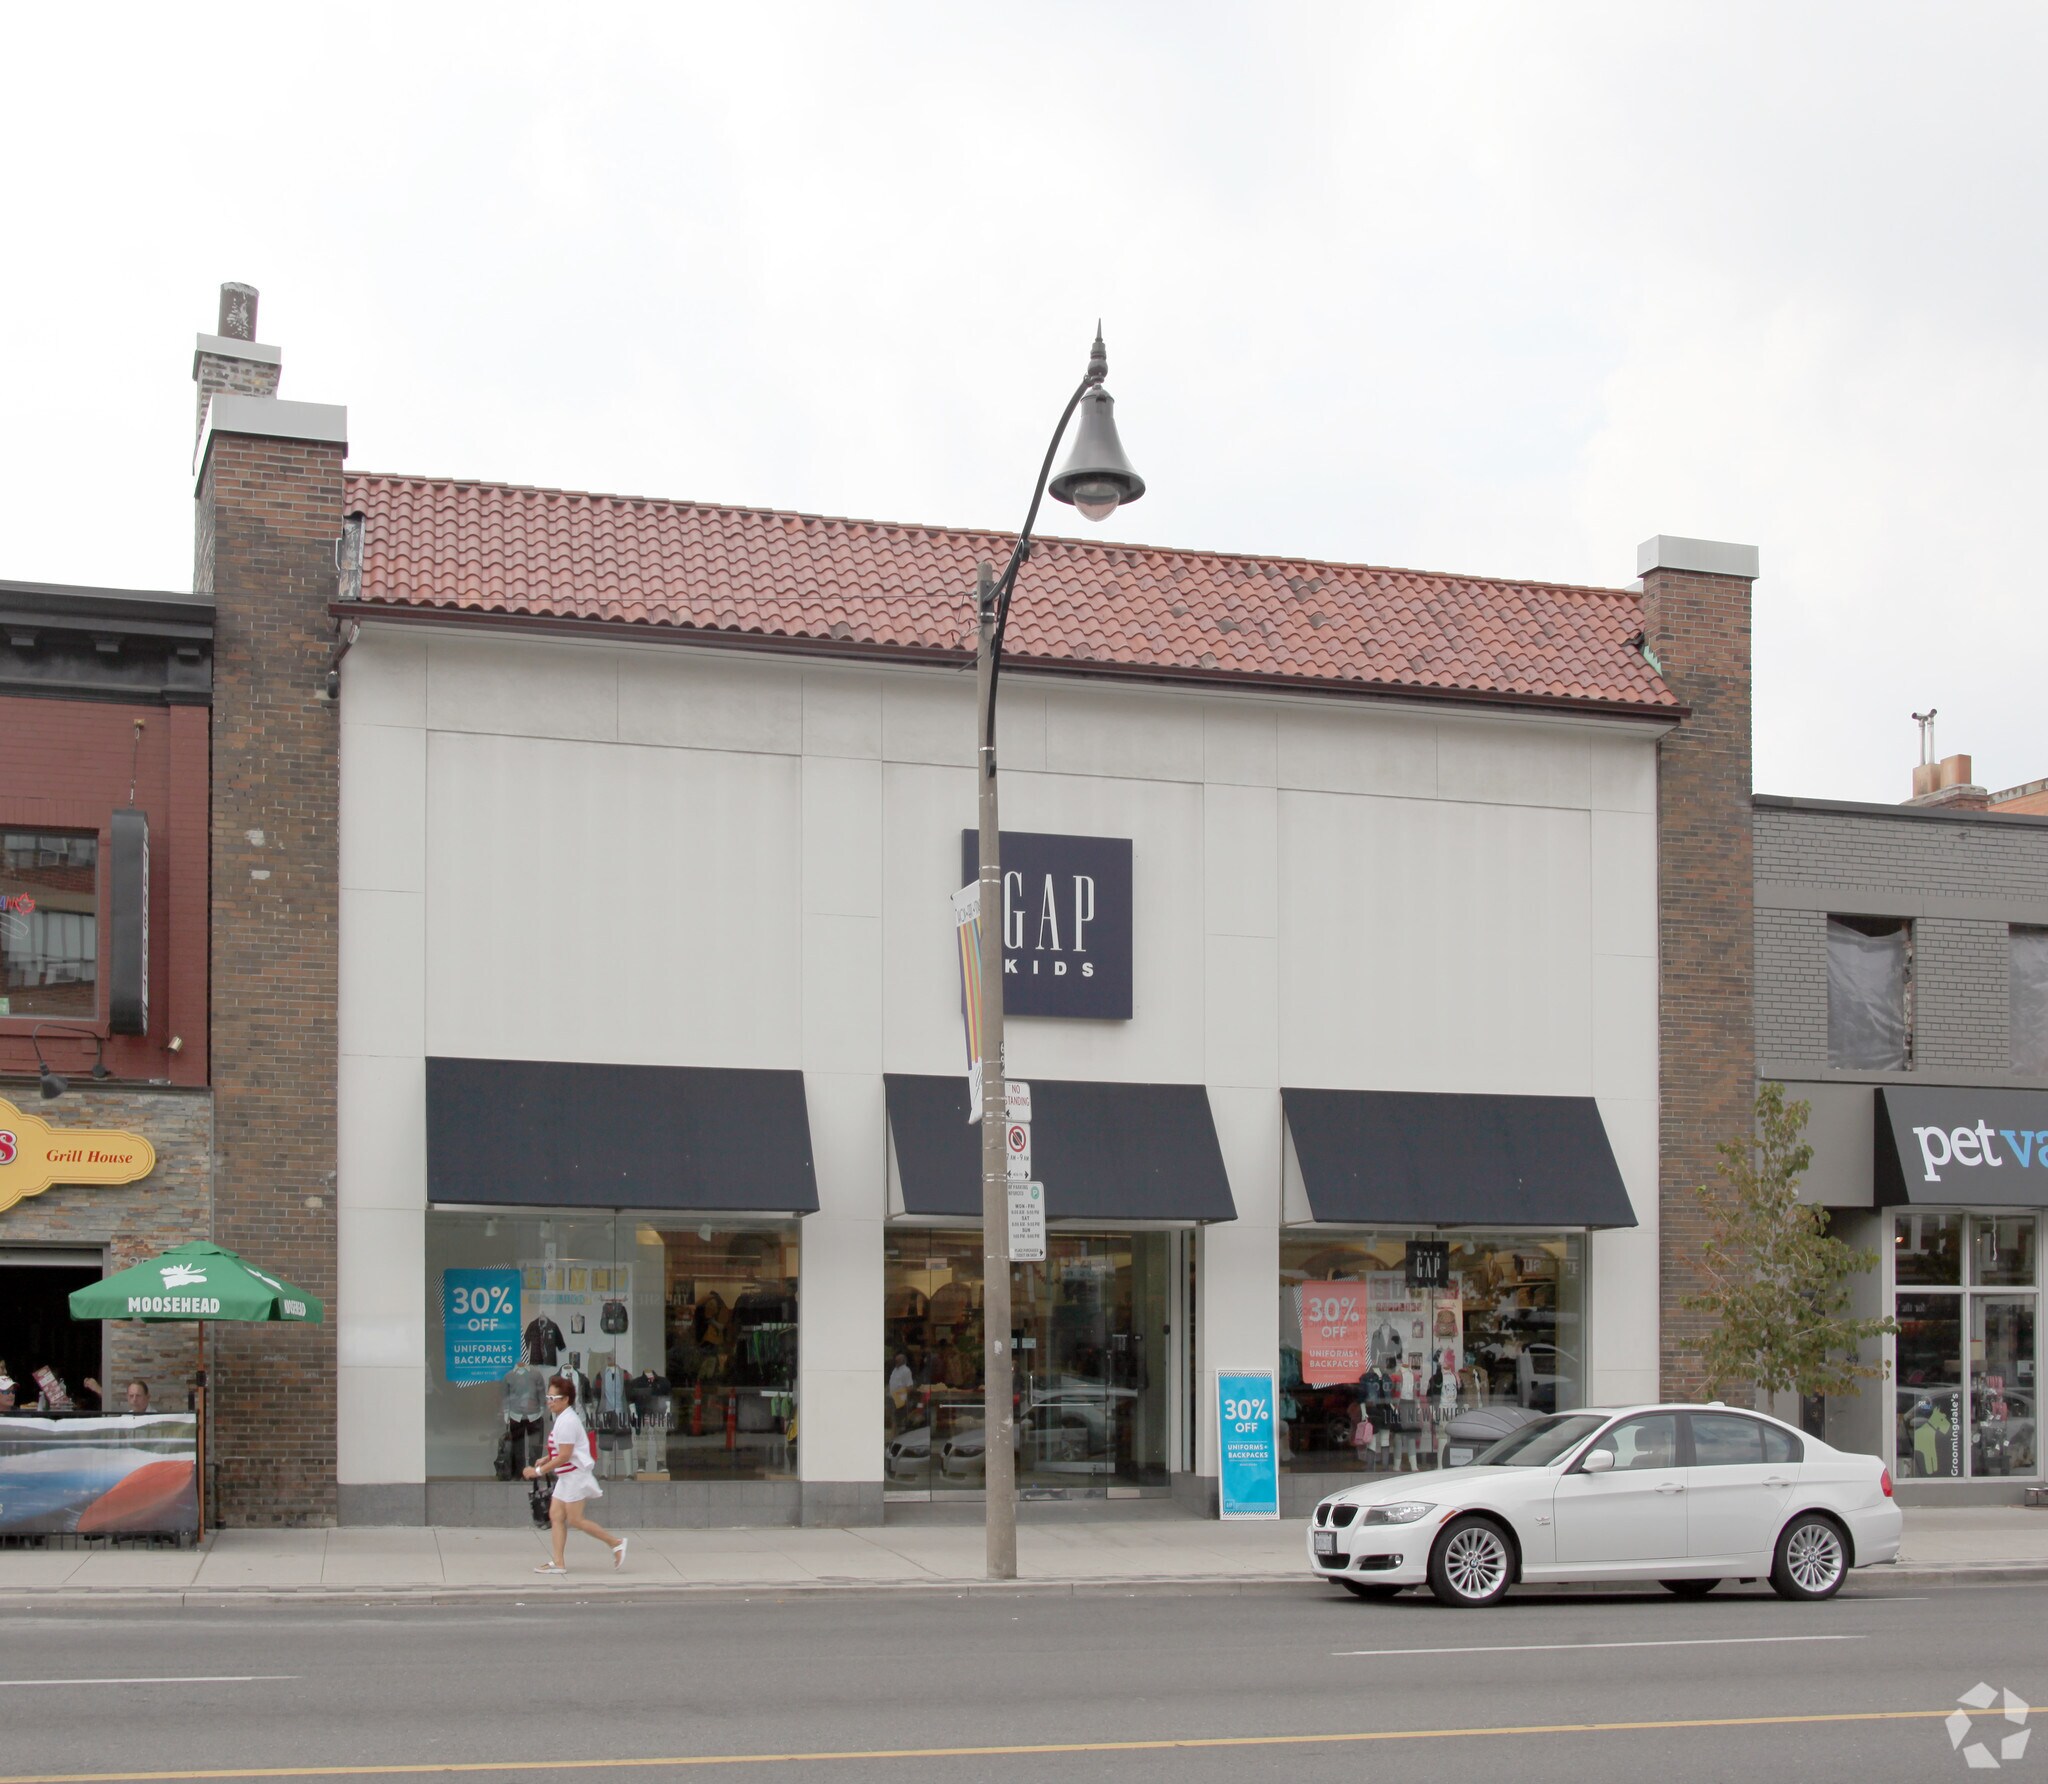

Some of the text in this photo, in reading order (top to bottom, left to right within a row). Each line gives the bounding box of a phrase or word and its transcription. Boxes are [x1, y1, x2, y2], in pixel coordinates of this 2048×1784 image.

[1003, 870, 1095, 952] GAP
[1004, 958, 1094, 977] KIDS
[1012, 1084, 1021, 1094] NO
[1005, 1096, 1030, 1106] STANDING
[46, 1149, 133, 1164] Grill House
[1912, 1119, 2003, 1182] pet
[1416, 1257, 1441, 1278] GAP
[128, 1297, 220, 1314] MOOSEHEAD
[452, 1286, 513, 1314] 30%
[1309, 1297, 1360, 1322] 30%
[468, 1318, 499, 1332] OFF
[1321, 1326, 1347, 1338] OFF
[454, 1356, 513, 1365] BACKPACKS
[1309, 1360, 1359, 1368] BACKPACKS
[1224, 1399, 1269, 1420] 30%
[1235, 1422, 1258, 1433] OFF
[1951, 1393, 1959, 1476] Groomingdale's
[1228, 1451, 1269, 1459] BACKPACKS
